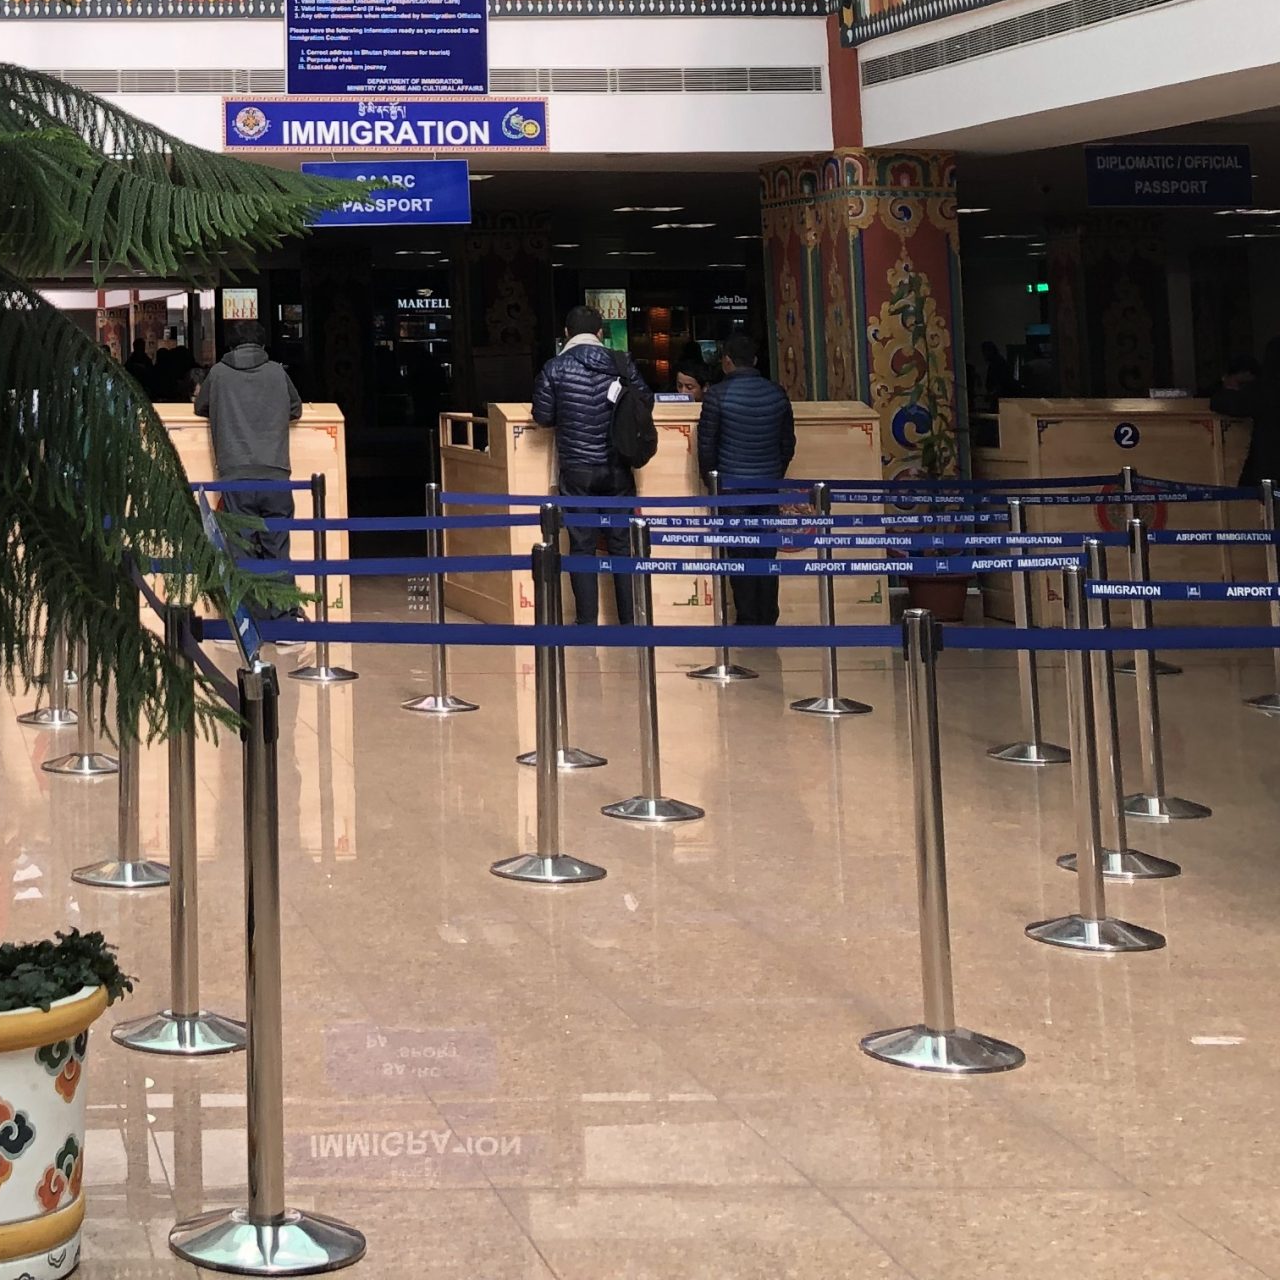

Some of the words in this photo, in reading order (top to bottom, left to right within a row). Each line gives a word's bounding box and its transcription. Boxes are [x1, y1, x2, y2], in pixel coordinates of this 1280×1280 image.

[282, 120, 490, 145] IMMIGRATION
[1096, 155, 1174, 170] DIPLOMATIC
[1176, 156, 1182, 170] /
[1184, 156, 1243, 169] OFFICIAL
[1134, 181, 1208, 195] PASSPORT
[342, 199, 433, 212] PASSPORT
[397, 298, 452, 309] MARTELL
[1120, 426, 1134, 445] 2
[672, 517, 682, 525] TO
[703, 518, 724, 526] LAND
[730, 518, 740, 526] OF
[743, 518, 759, 526] THE
[762, 518, 798, 526] THUNDER
[801, 517, 834, 526] DRAGON
[880, 516, 919, 524] WELCOME
[936, 515, 951, 523] THE
[980, 514, 990, 522] OF
[662, 535, 699, 543] AIRPORT
[704, 536, 760, 544] IMMIGRATION
[814, 537, 851, 545] AIRPORT
[856, 537, 911, 545] IMMIGRATION
[965, 537, 1001, 545] AIRPORT
[1006, 536, 1062, 544] IMMIGRATION
[1176, 533, 1212, 541] AIRPORT
[1216, 533, 1271, 541] IMMIGRATION
[635, 562, 677, 571] AIRPORT
[682, 563, 745, 572] IMMIGRATION
[805, 562, 846, 571] AIRPORT
[851, 562, 913, 571] IMMIGRATION
[971, 560, 1012, 570] AIRPORT
[1018, 557, 1080, 568] IMMIGRATION
[1092, 585, 1161, 596] IMMIGRATION
[1226, 586, 1273, 597] AIRPORT
